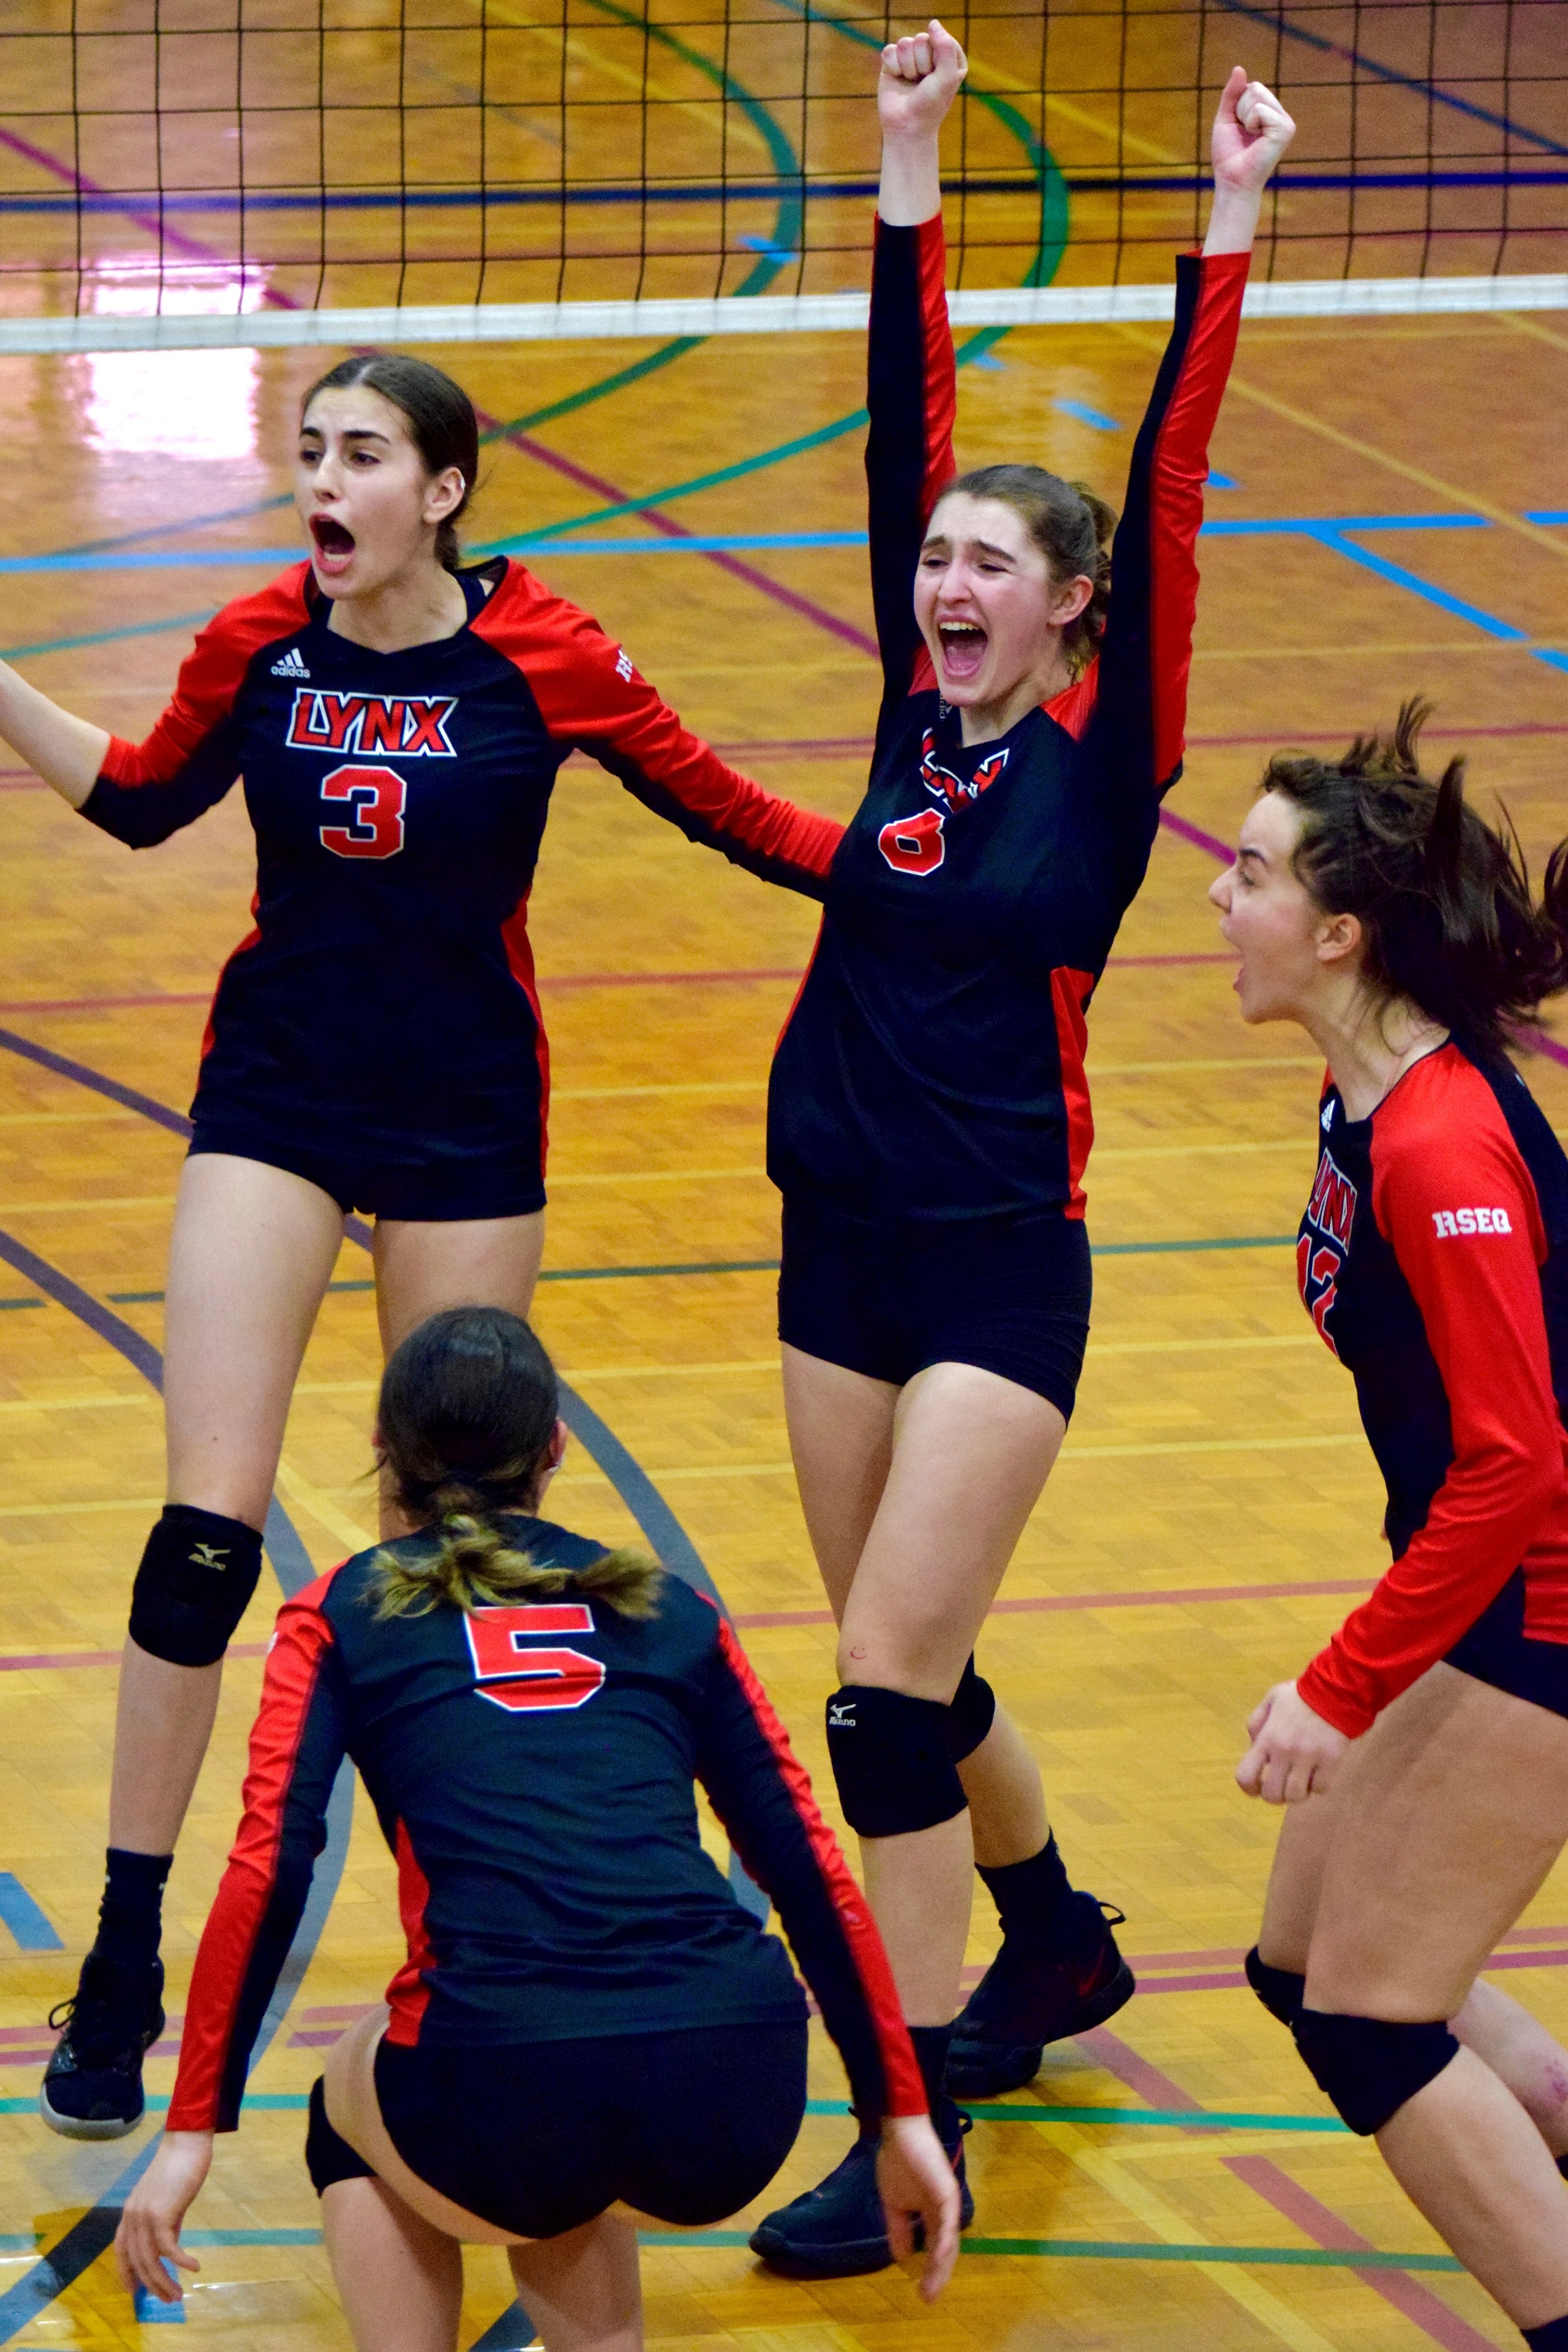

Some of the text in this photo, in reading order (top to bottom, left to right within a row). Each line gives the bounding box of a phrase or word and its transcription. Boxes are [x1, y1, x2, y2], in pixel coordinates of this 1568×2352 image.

[271, 665, 311, 679] adidas
[285, 687, 459, 757] LYNX
[319, 764, 407, 859] 3
[1432, 1207, 1512, 1238] RSEQ
[462, 1602, 607, 1712] 5
